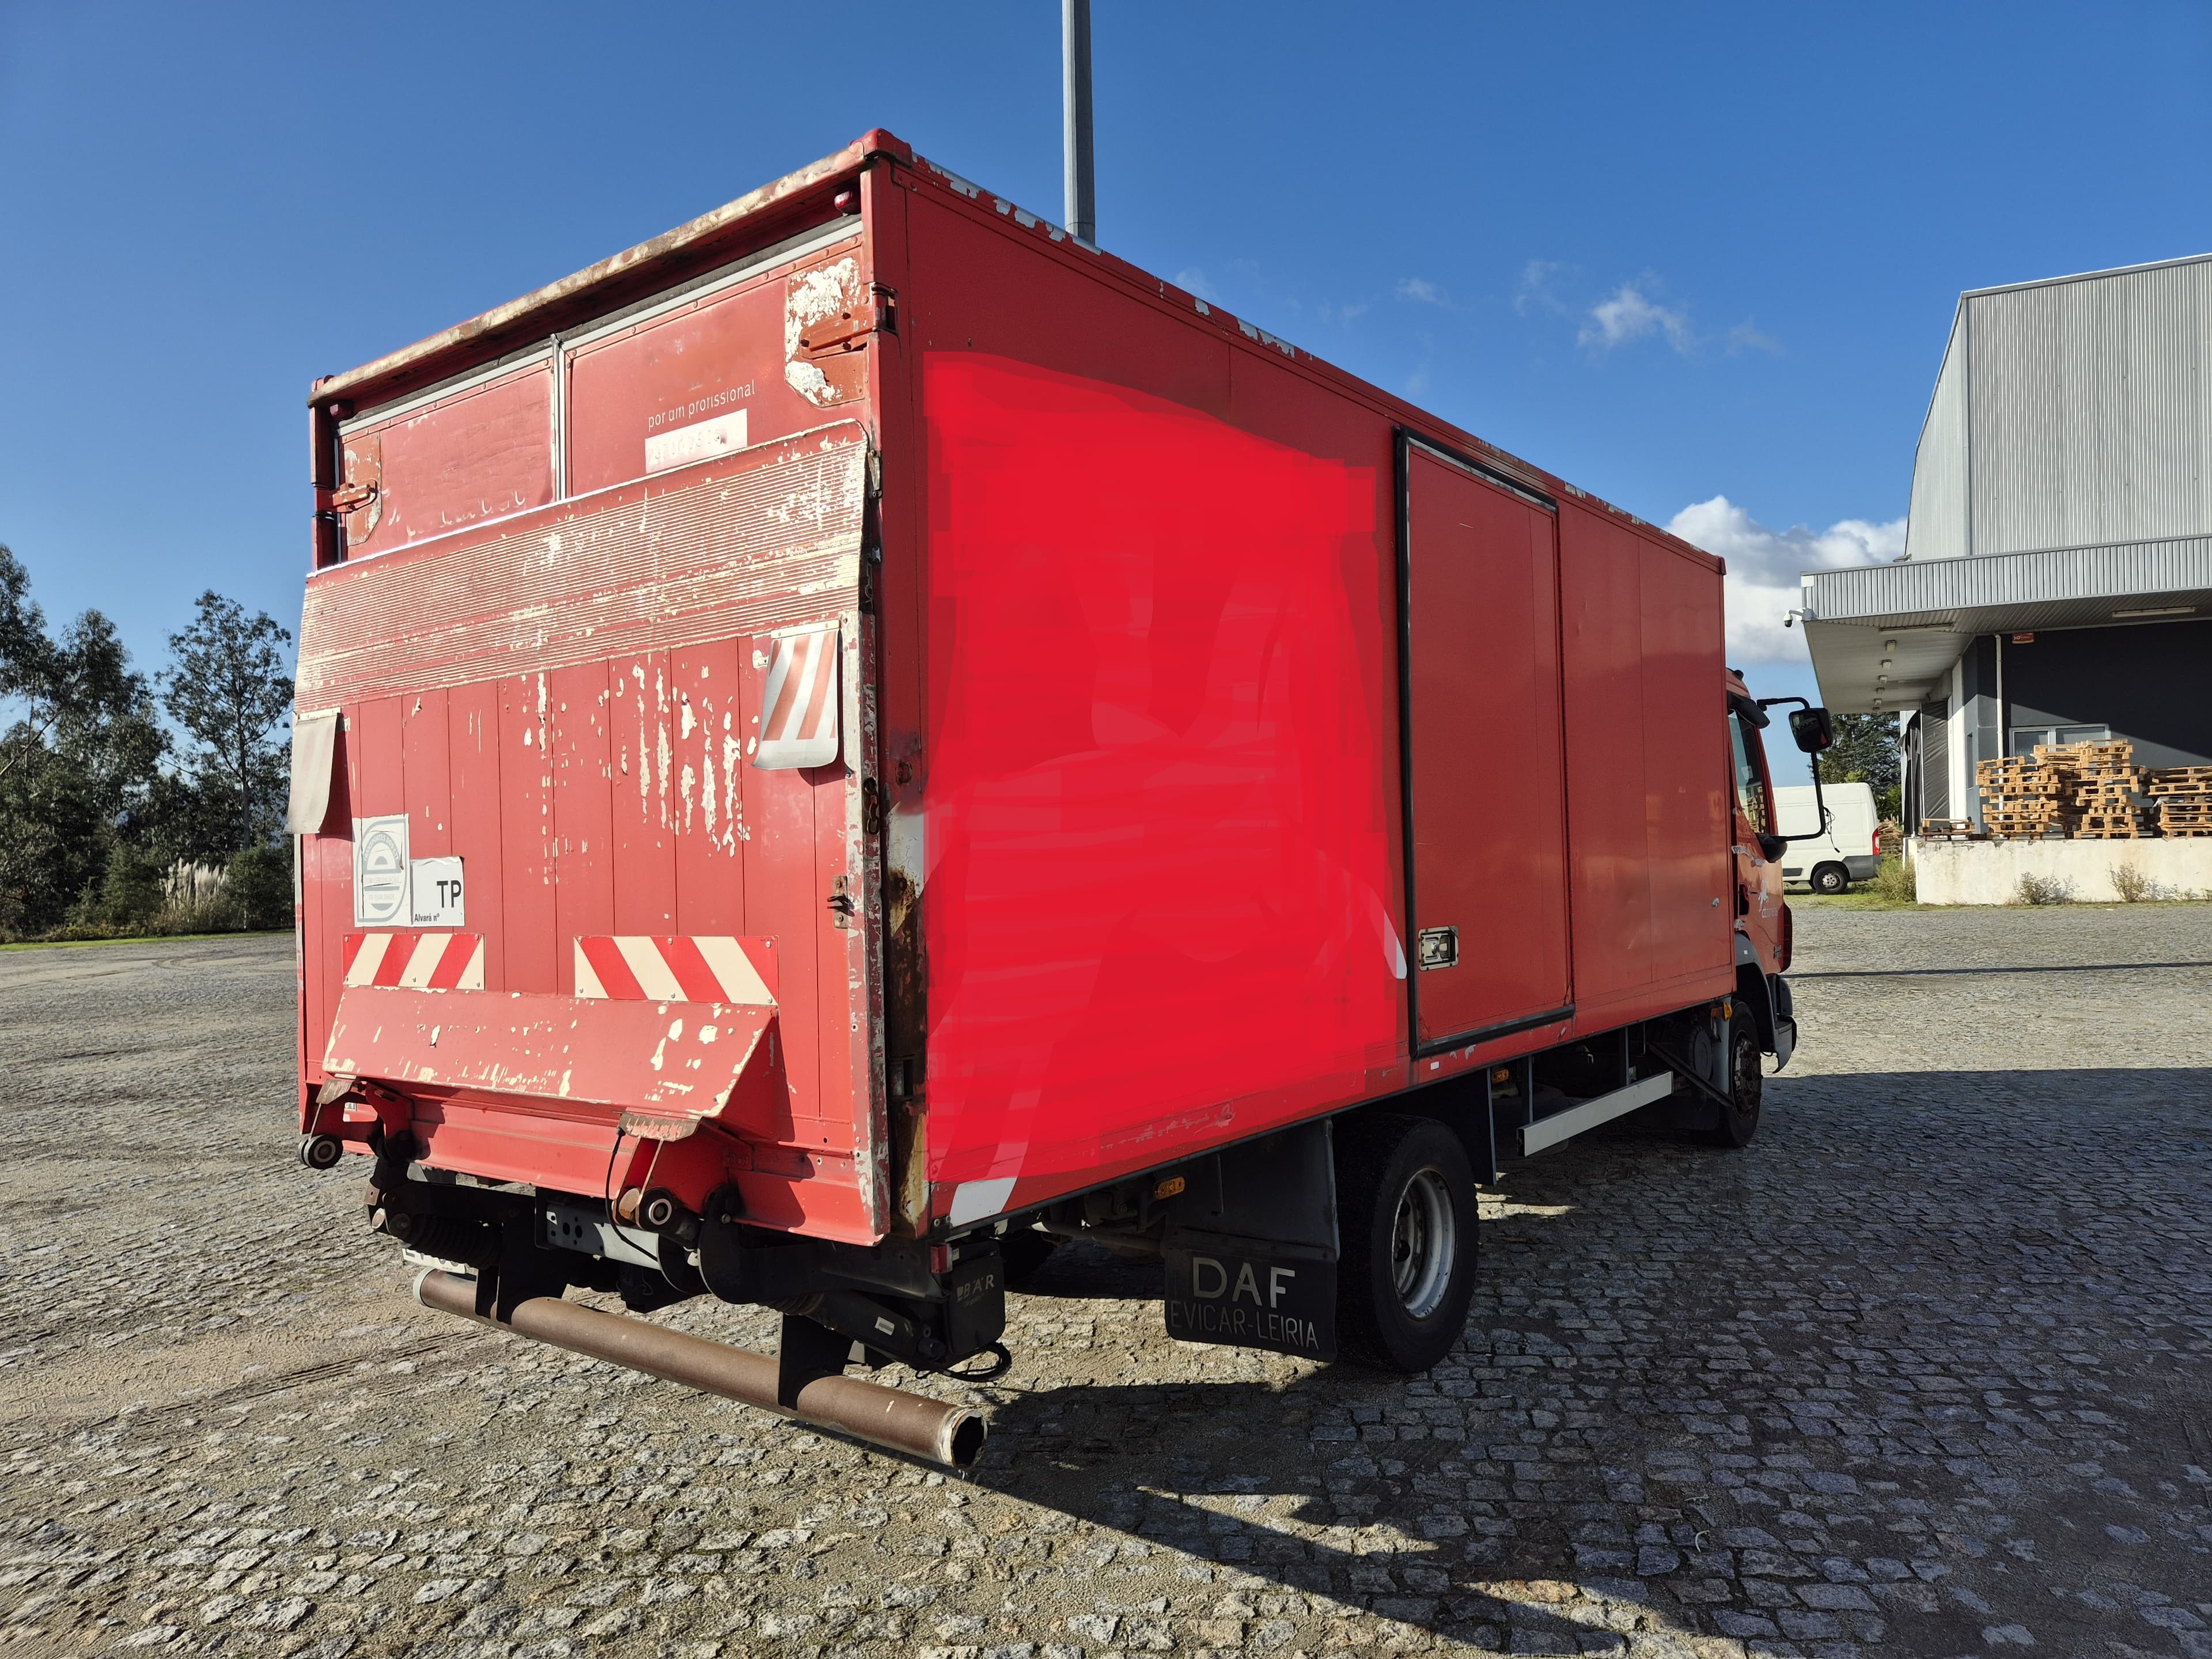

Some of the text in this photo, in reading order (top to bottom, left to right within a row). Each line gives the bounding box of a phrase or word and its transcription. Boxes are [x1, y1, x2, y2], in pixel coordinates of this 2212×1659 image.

[648, 412, 665, 432] por
[437, 880, 461, 908] TP
[414, 913, 432, 922] Alvará
[1193, 1257, 1296, 1308] DAF
